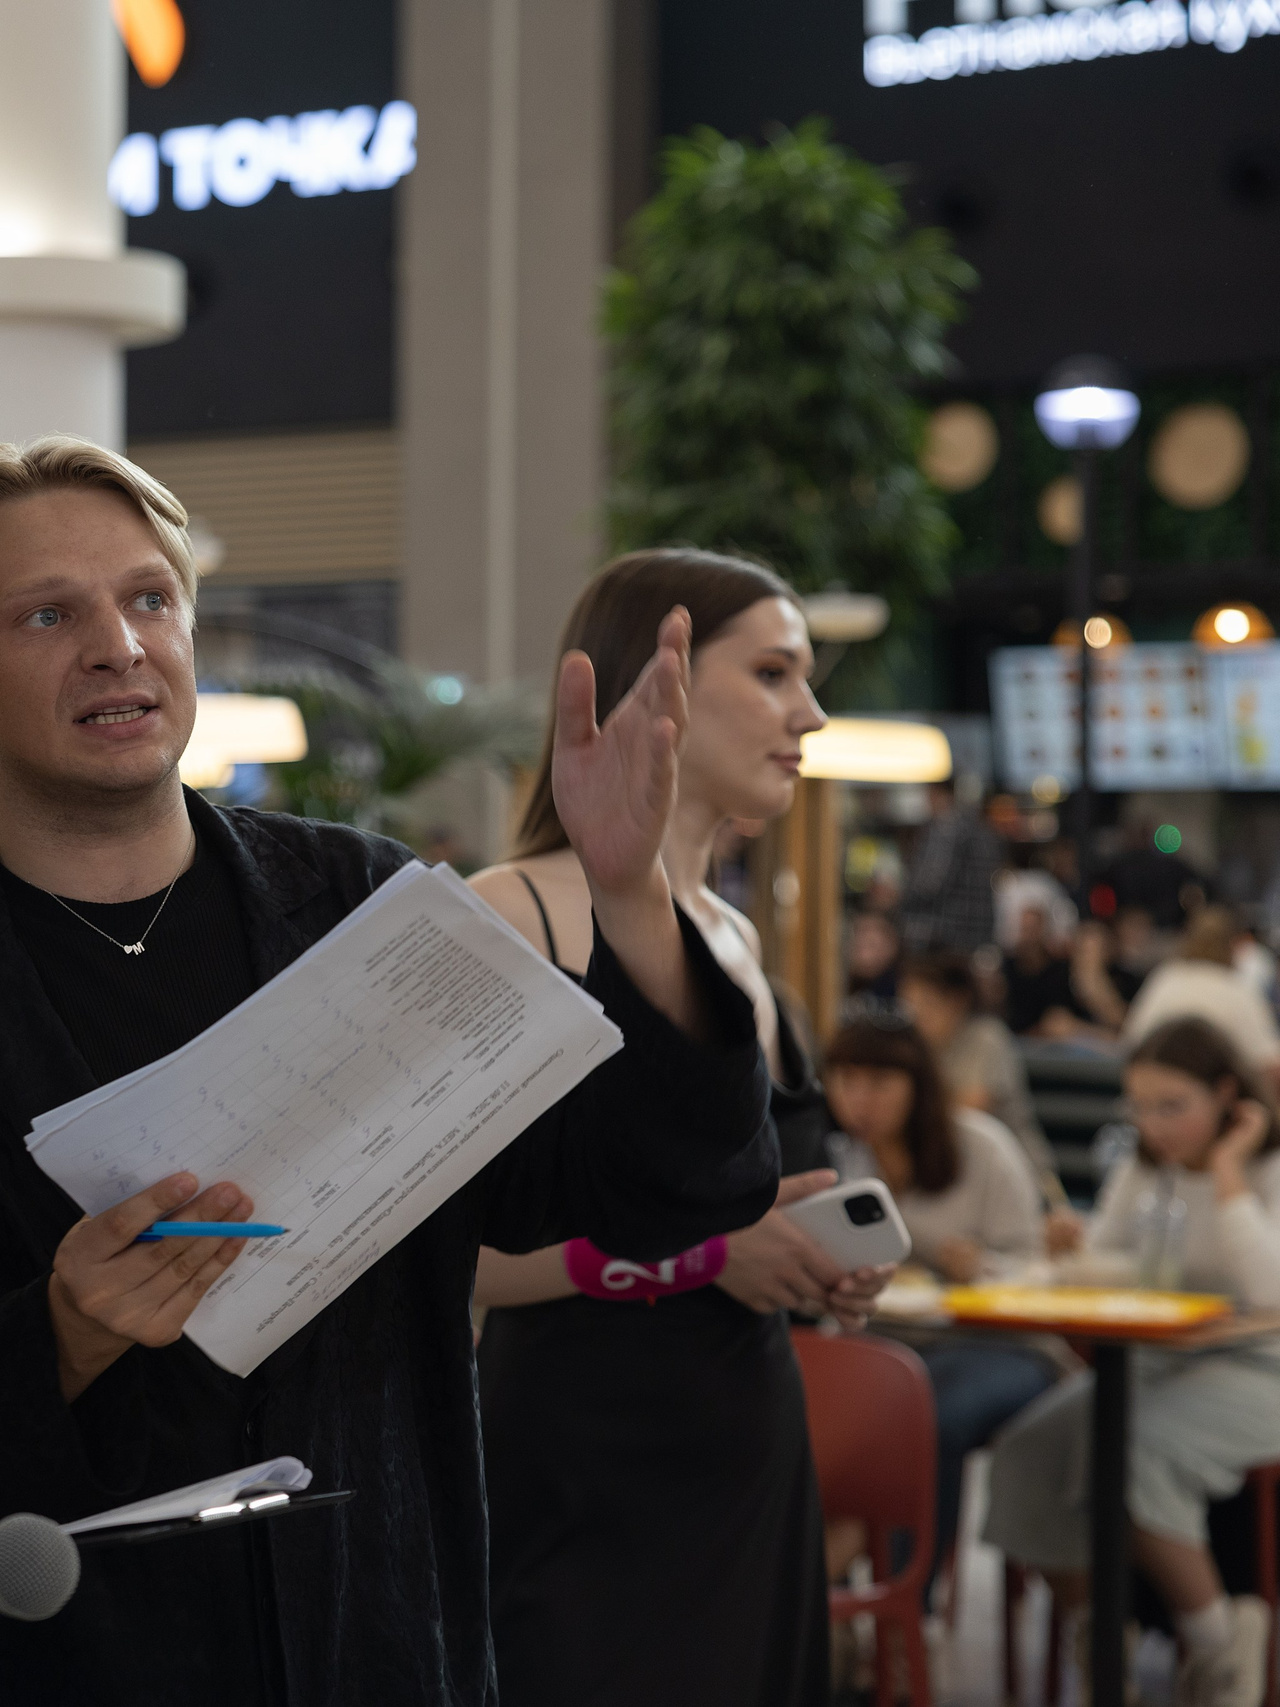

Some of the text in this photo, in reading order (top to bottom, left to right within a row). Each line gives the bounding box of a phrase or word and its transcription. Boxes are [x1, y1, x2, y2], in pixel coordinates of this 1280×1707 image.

[159, 100, 418, 209] ТОЧКА
[434, 1125, 460, 1151] МЕГА
[401, 1147, 437, 1181] Дыбенко
